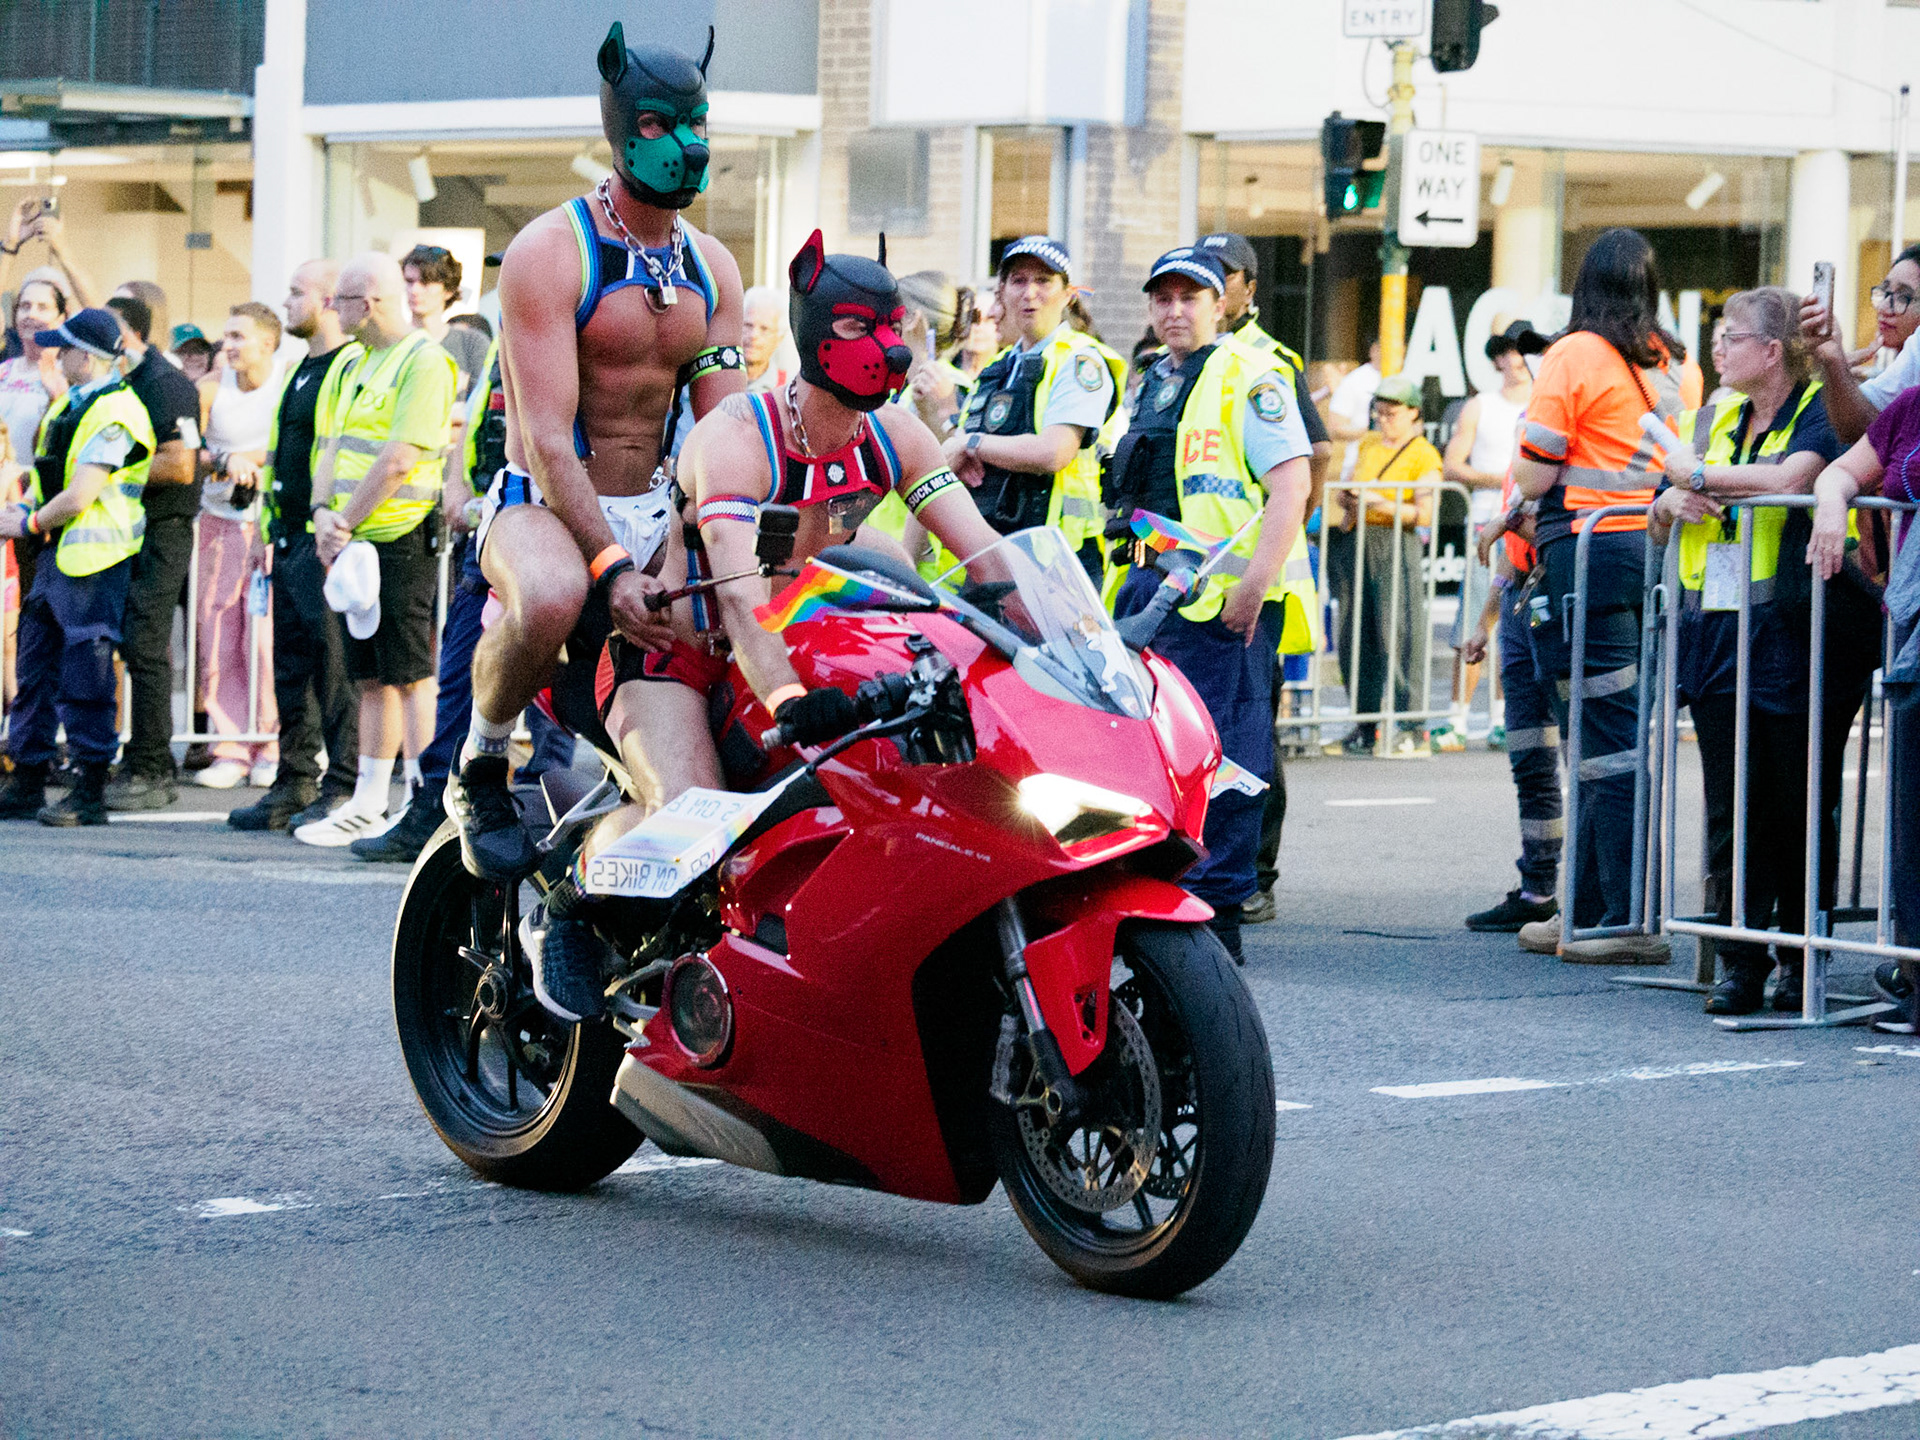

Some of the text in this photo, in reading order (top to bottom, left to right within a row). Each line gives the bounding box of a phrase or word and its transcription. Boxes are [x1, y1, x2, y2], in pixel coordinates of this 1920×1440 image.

[1350, 9, 1416, 27] ENTRY
[1419, 140, 1466, 165] ONE
[1417, 176, 1465, 200] WAY
[699, 354, 715, 369] ME
[908, 474, 946, 508] SUCK ME
